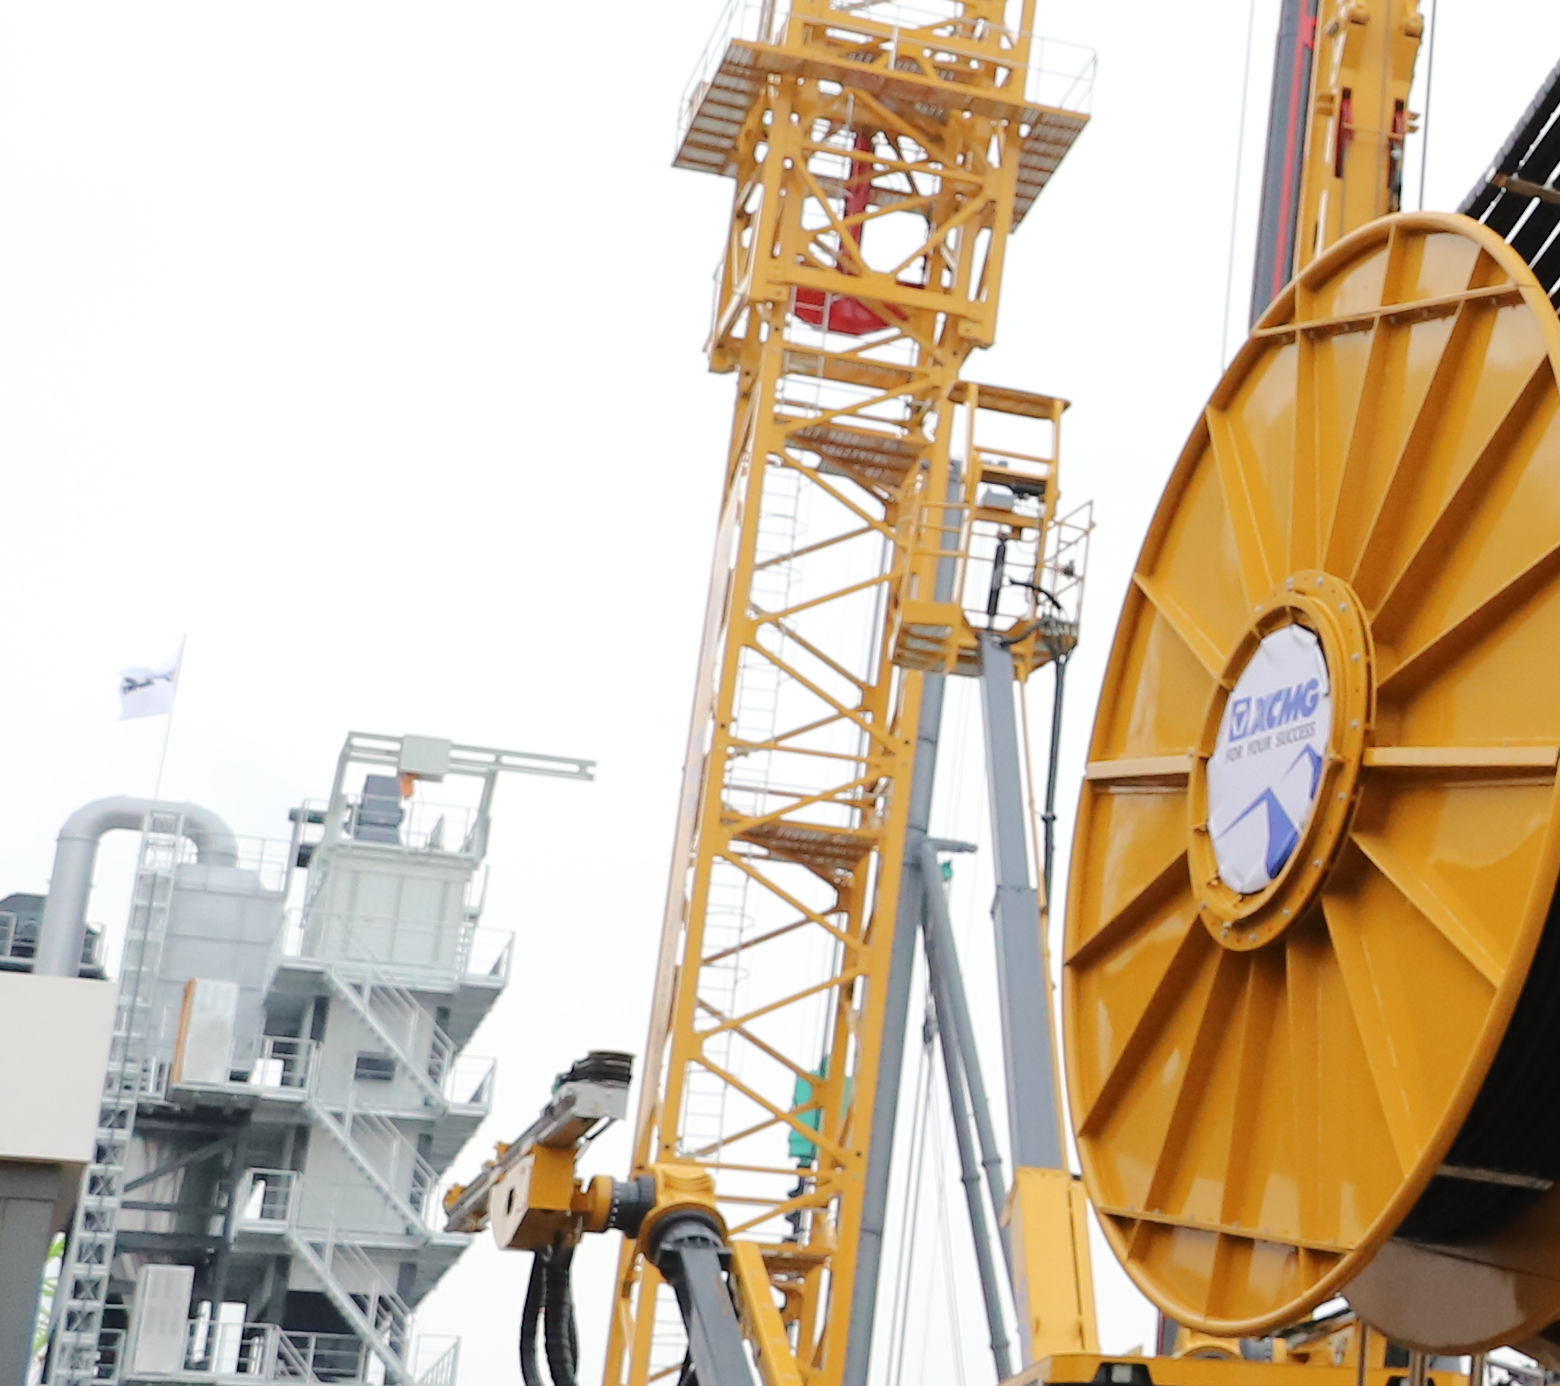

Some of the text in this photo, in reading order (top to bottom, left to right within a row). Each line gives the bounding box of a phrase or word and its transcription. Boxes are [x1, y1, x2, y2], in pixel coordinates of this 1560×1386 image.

[1249, 678, 1319, 735] XCMG
[1225, 721, 1316, 763] FOR YOUR SUCCESS
